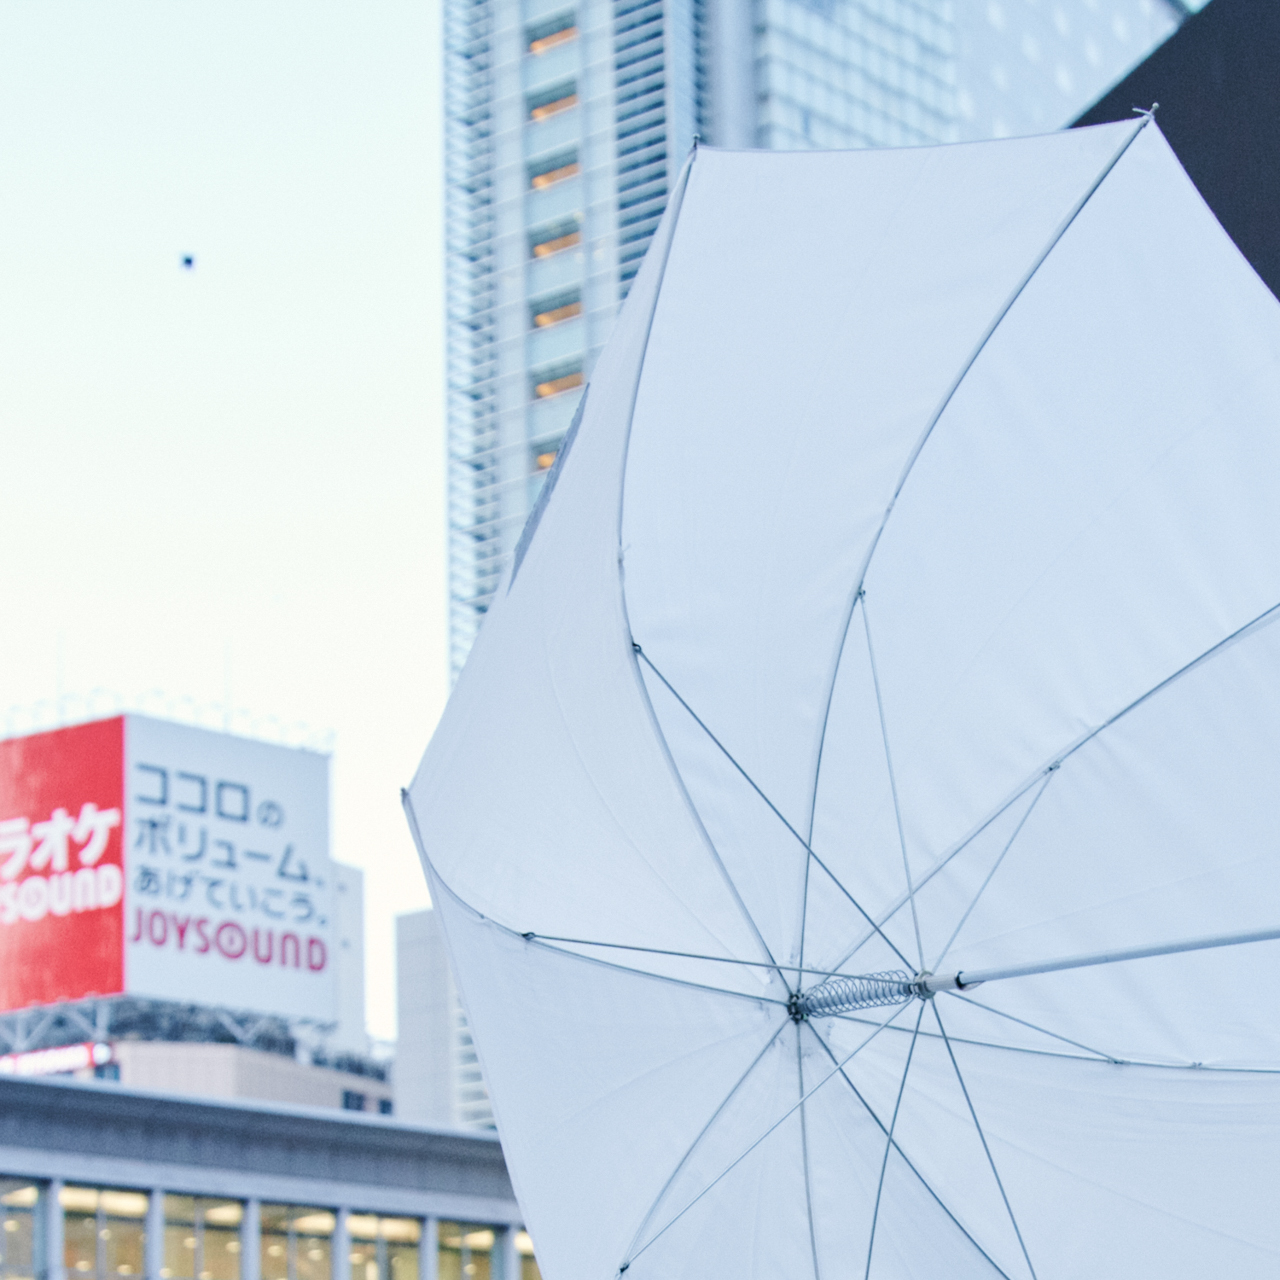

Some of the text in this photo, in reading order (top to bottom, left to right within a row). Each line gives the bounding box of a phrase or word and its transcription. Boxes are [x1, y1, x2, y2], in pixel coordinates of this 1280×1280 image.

[132, 760, 286, 832] ココロの
[131, 906, 329, 974] JOYSOUND
